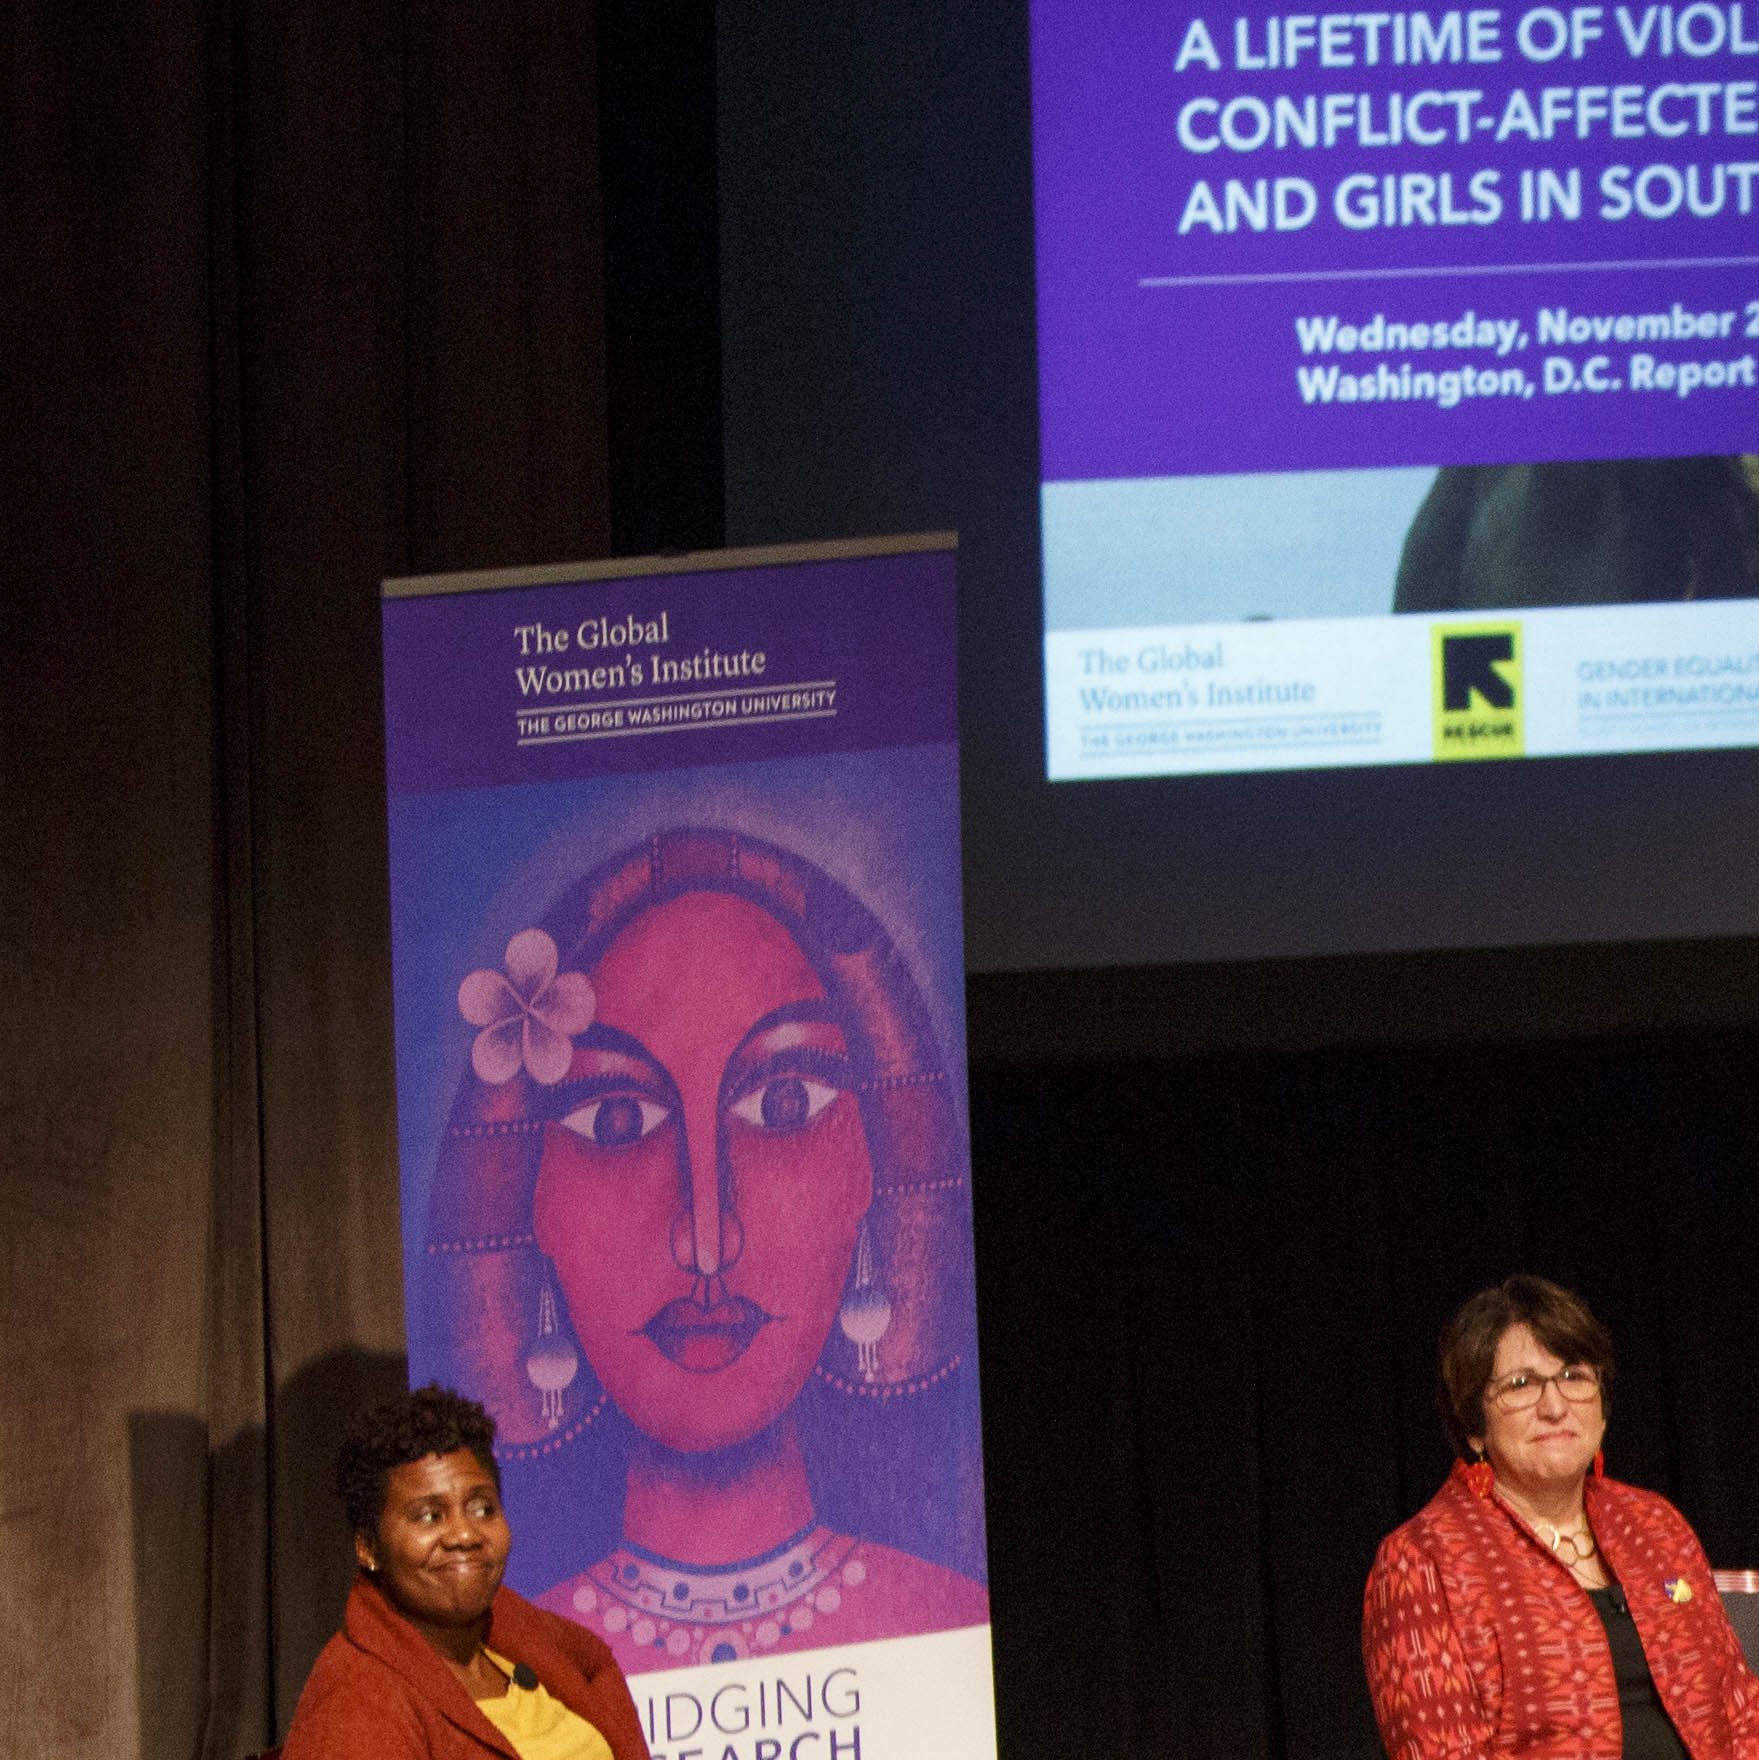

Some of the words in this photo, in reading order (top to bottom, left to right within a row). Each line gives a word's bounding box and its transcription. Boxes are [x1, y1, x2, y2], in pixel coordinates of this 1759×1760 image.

[1174, 18, 1221, 72] A
[1235, 9, 1502, 71] LIFETIME
[1516, 6, 1603, 62] OF
[1178, 177, 1318, 235] AND
[1333, 169, 1503, 230] GIRLS
[1520, 168, 1581, 223] IN
[1296, 311, 1529, 356] Wednesday,
[1537, 303, 1735, 345] November
[1297, 363, 1534, 408] Washington,
[1543, 355, 1622, 395] D.C.
[1630, 352, 1756, 398] Report
[513, 623, 569, 655] The
[576, 610, 669, 650] Global
[515, 654, 644, 696] Women's
[651, 648, 767, 685] Institute
[1079, 648, 1129, 675] The
[1137, 641, 1224, 674] Global
[1576, 658, 1668, 681] GENDER
[517, 717, 550, 736] THE
[554, 711, 624, 731] GEORGE
[628, 700, 737, 725] WASHINGTON
[741, 689, 837, 715] UNIVERSITY
[1080, 678, 1199, 712] Women's
[1207, 676, 1317, 707] Institute
[1578, 689, 1601, 711] IN
[648, 1668, 861, 1745] IDGING
